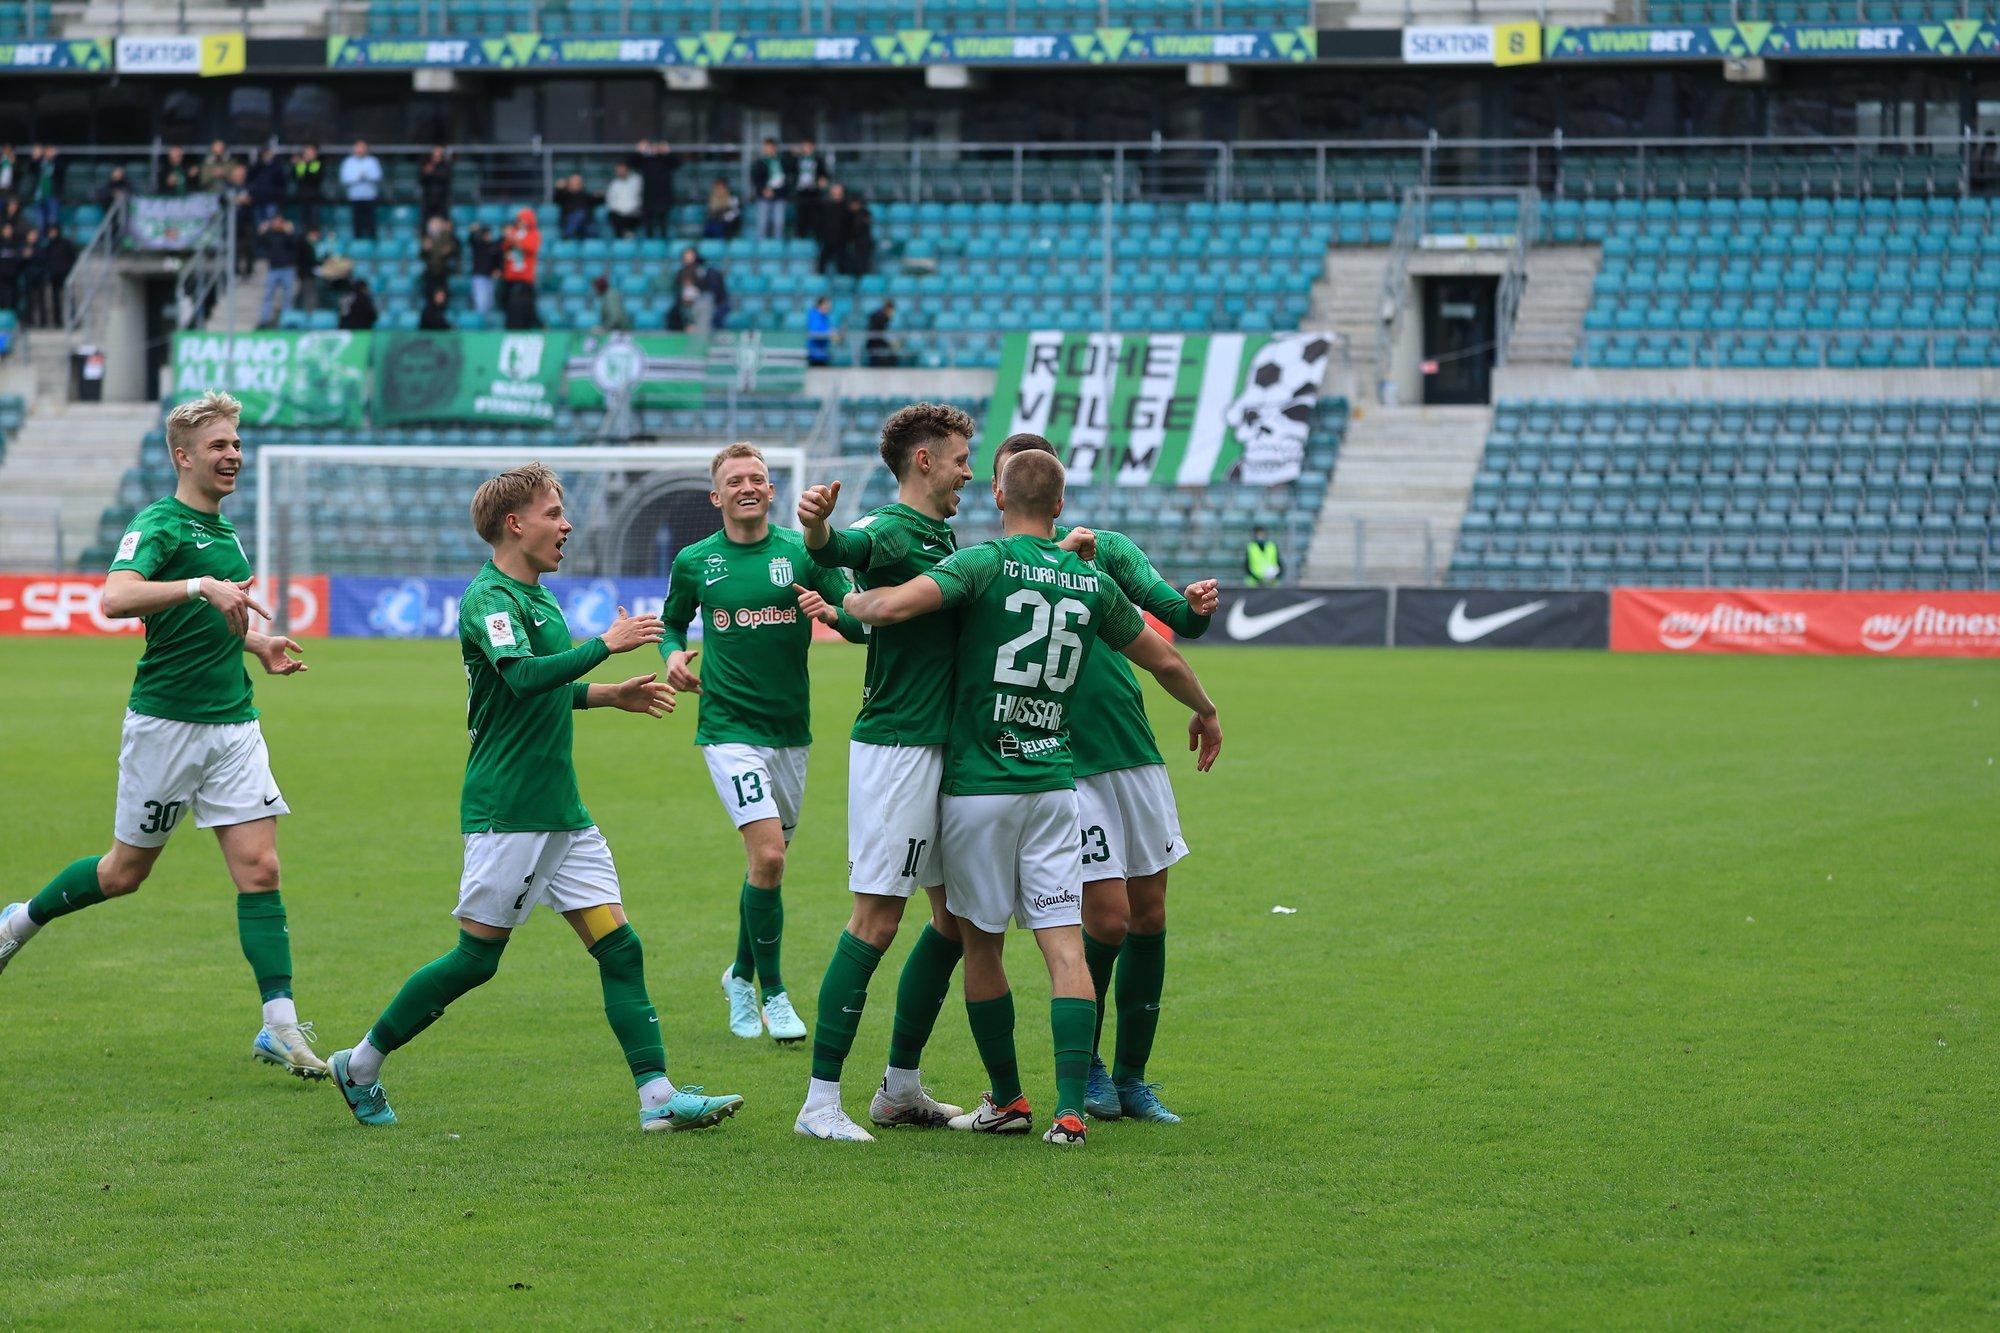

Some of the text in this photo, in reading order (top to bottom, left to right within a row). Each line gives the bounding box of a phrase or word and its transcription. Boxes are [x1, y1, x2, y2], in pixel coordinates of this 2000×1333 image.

[213, 41, 230, 65] 7
[1411, 31, 1526, 53] SEKTOR 8
[1588, 30, 1694, 51] VIVATBET
[1795, 28, 1904, 50] VIVATBET
[1030, 343, 1198, 378] ROHE-
[1018, 393, 1198, 430] VALGE
[1003, 559, 1019, 578] FC
[1021, 564, 1056, 585] FLORA
[735, 606, 797, 629] Optibet
[1659, 602, 1807, 649] myfitness
[1861, 605, 2000, 652] myfitnes
[994, 588, 1092, 693] 26
[993, 693, 1063, 731] HUSSAR
[1020, 737, 1061, 754] SELVER
[731, 771, 764, 808] 13
[139, 799, 182, 834] 30
